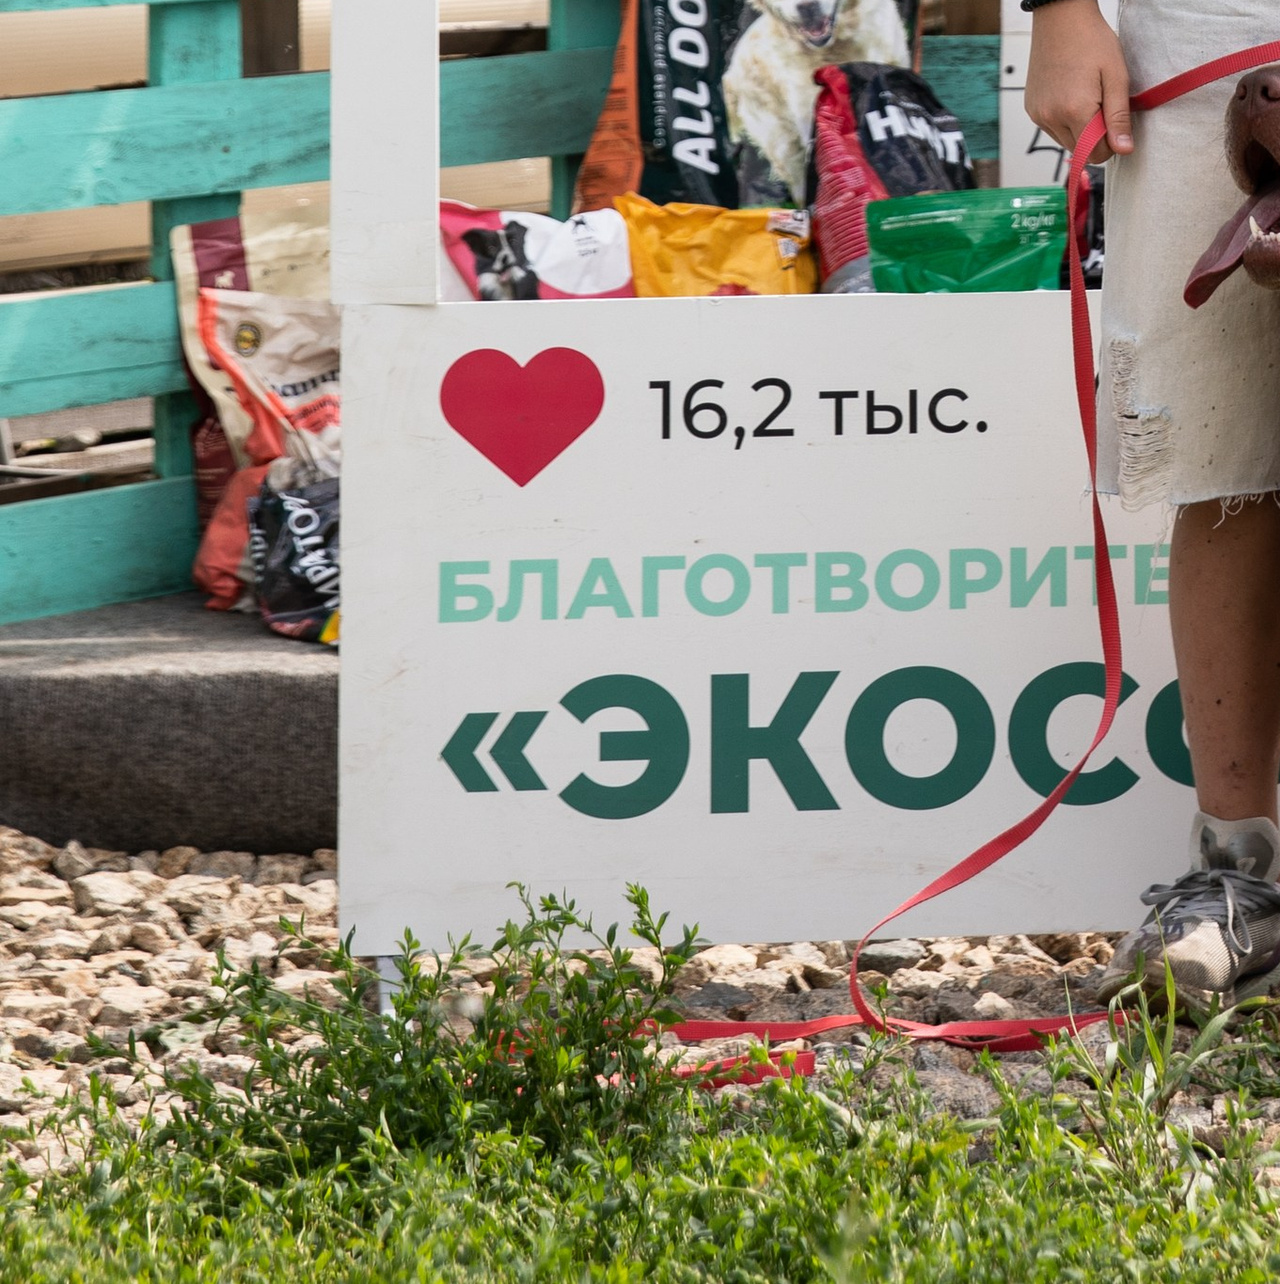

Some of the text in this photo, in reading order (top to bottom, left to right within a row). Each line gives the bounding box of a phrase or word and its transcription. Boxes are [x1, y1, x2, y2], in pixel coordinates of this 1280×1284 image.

[672, 80, 720, 175] ALL
[649, 376, 988, 451] 16,2 тыс.
[437, 543, 1172, 624] БЛАГОТВОРИТЕ
